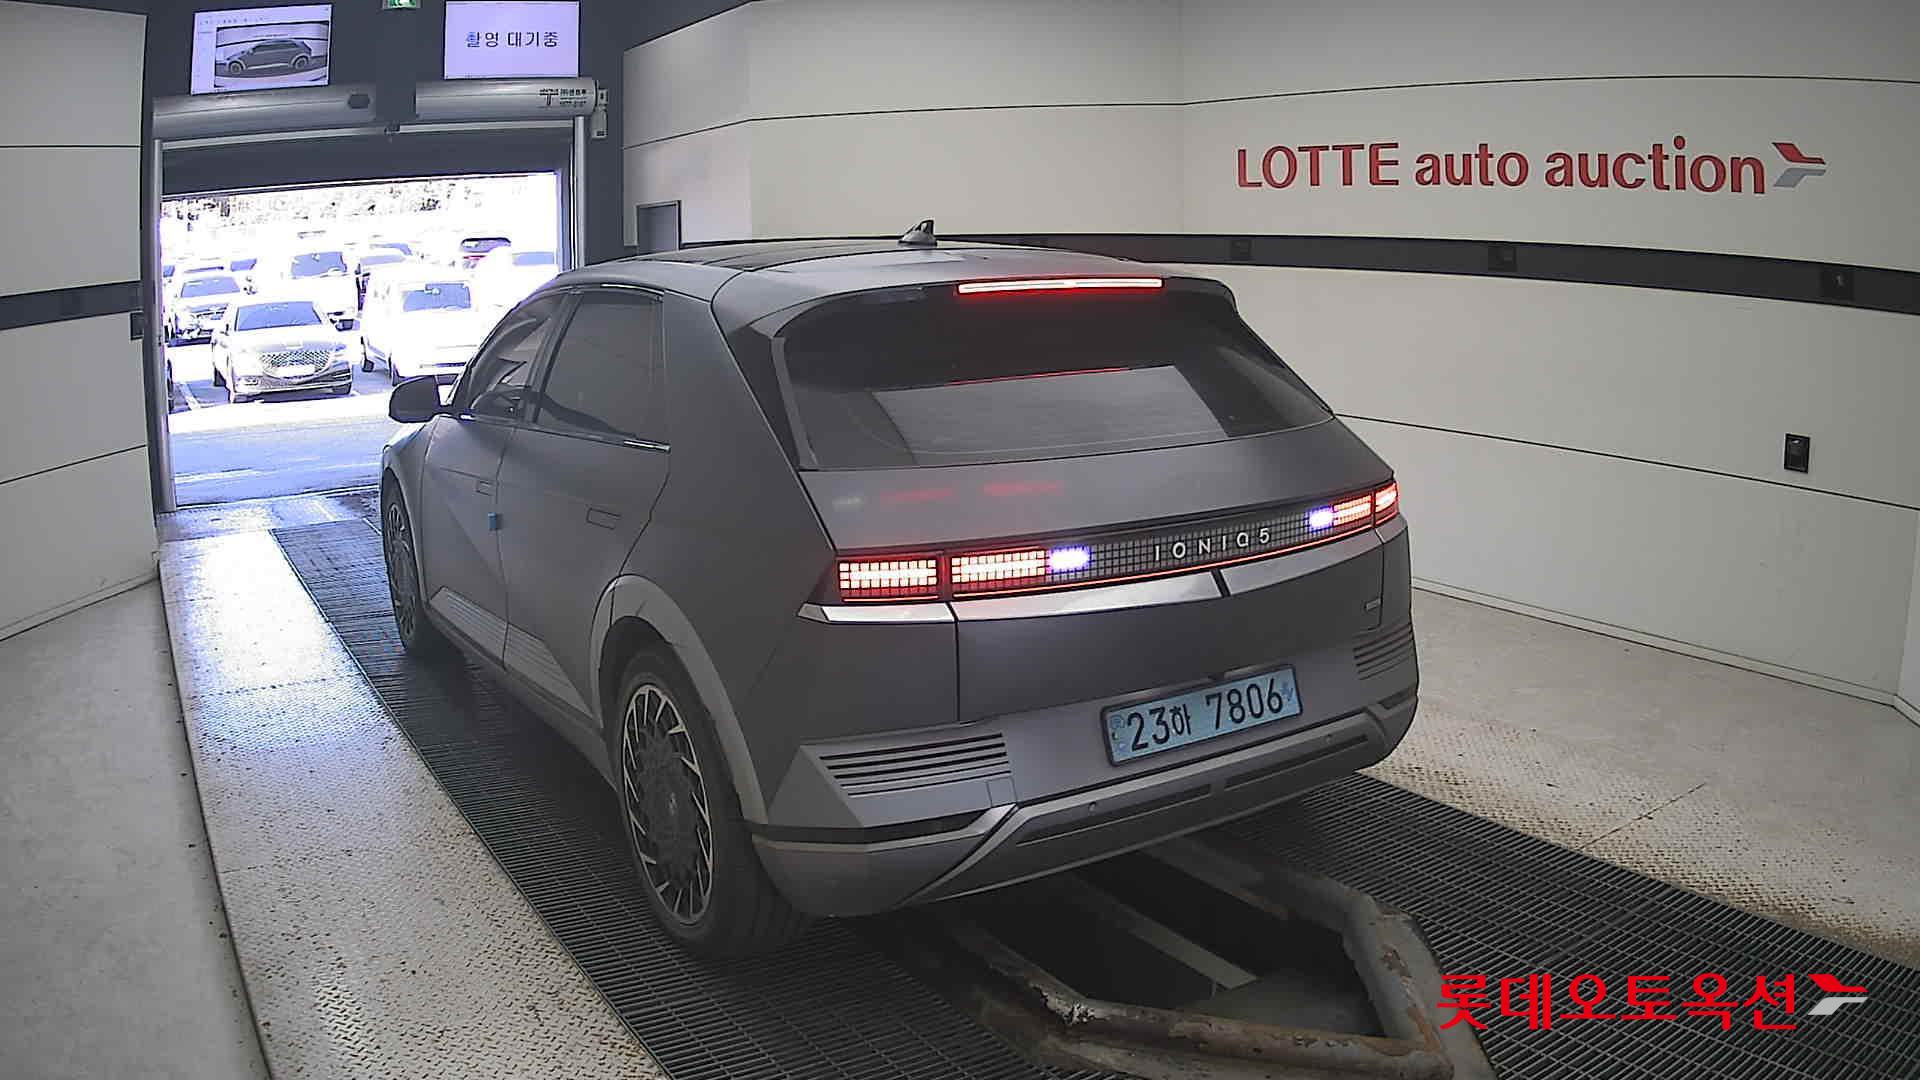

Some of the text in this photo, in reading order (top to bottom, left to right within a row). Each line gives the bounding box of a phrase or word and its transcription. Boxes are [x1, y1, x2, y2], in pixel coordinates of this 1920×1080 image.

[466, 31, 559, 48] 촬영 대기중
[1237, 135, 1766, 195] LOTTE auto auction
[1127, 677, 1283, 752] 23하 7806
